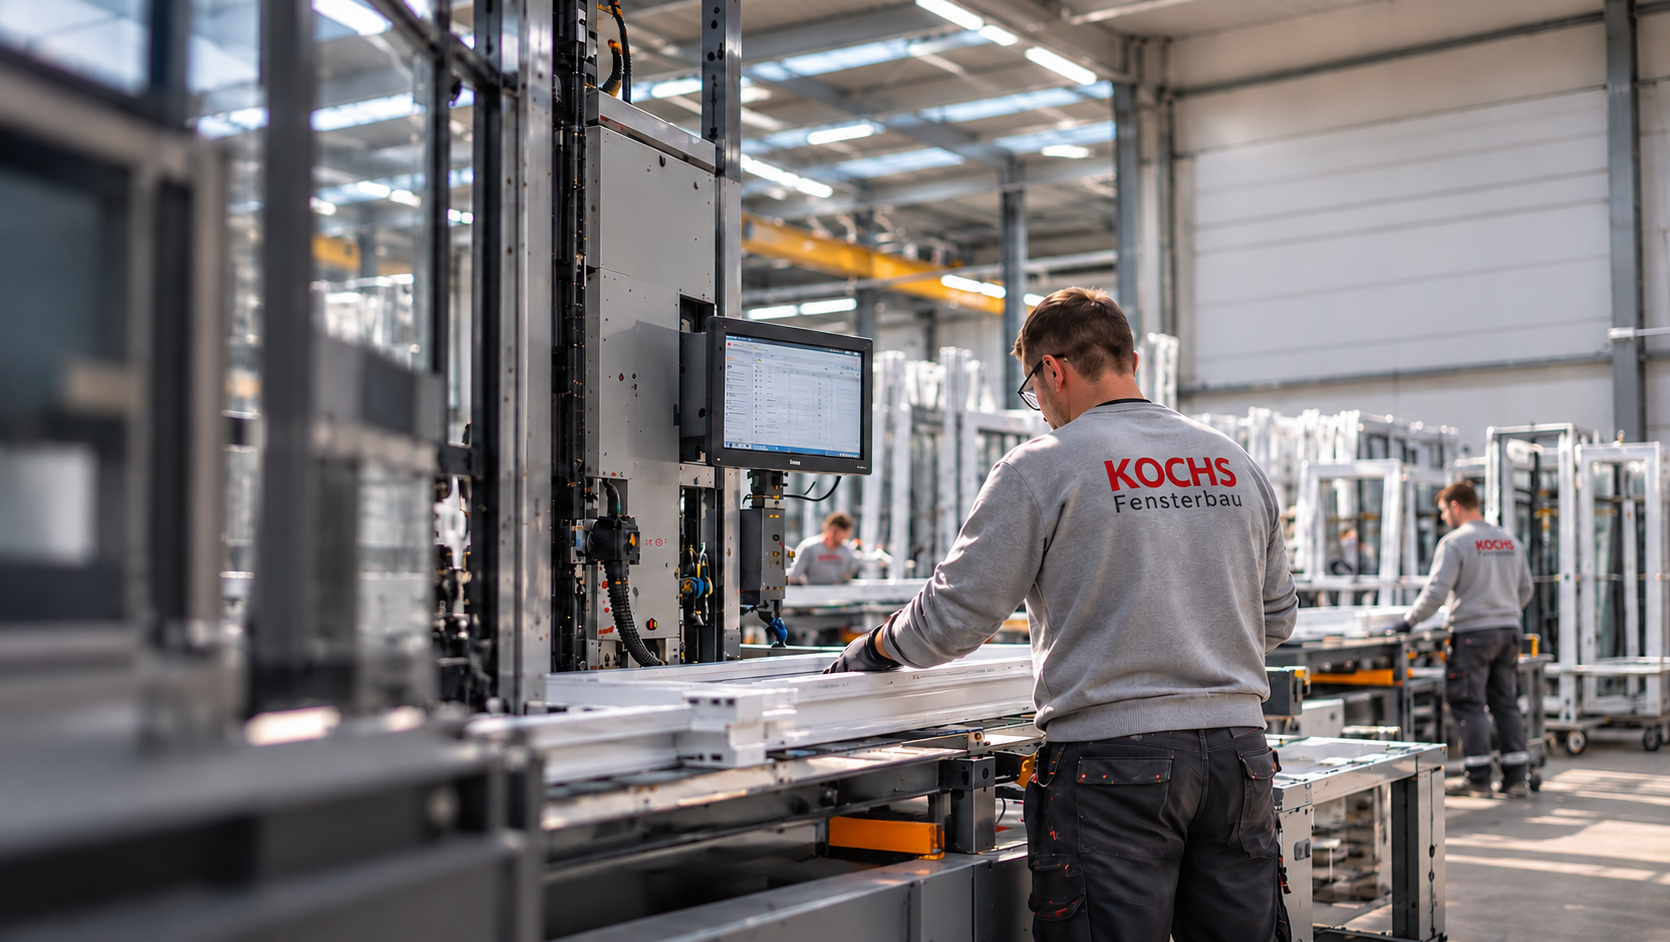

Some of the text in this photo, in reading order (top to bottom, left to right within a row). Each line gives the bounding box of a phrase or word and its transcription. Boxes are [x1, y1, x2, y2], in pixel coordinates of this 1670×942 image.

[1104, 457, 1237, 492] KOCHS
[1114, 490, 1242, 513] Fensterbau
[1475, 539, 1514, 551] KOCHS
